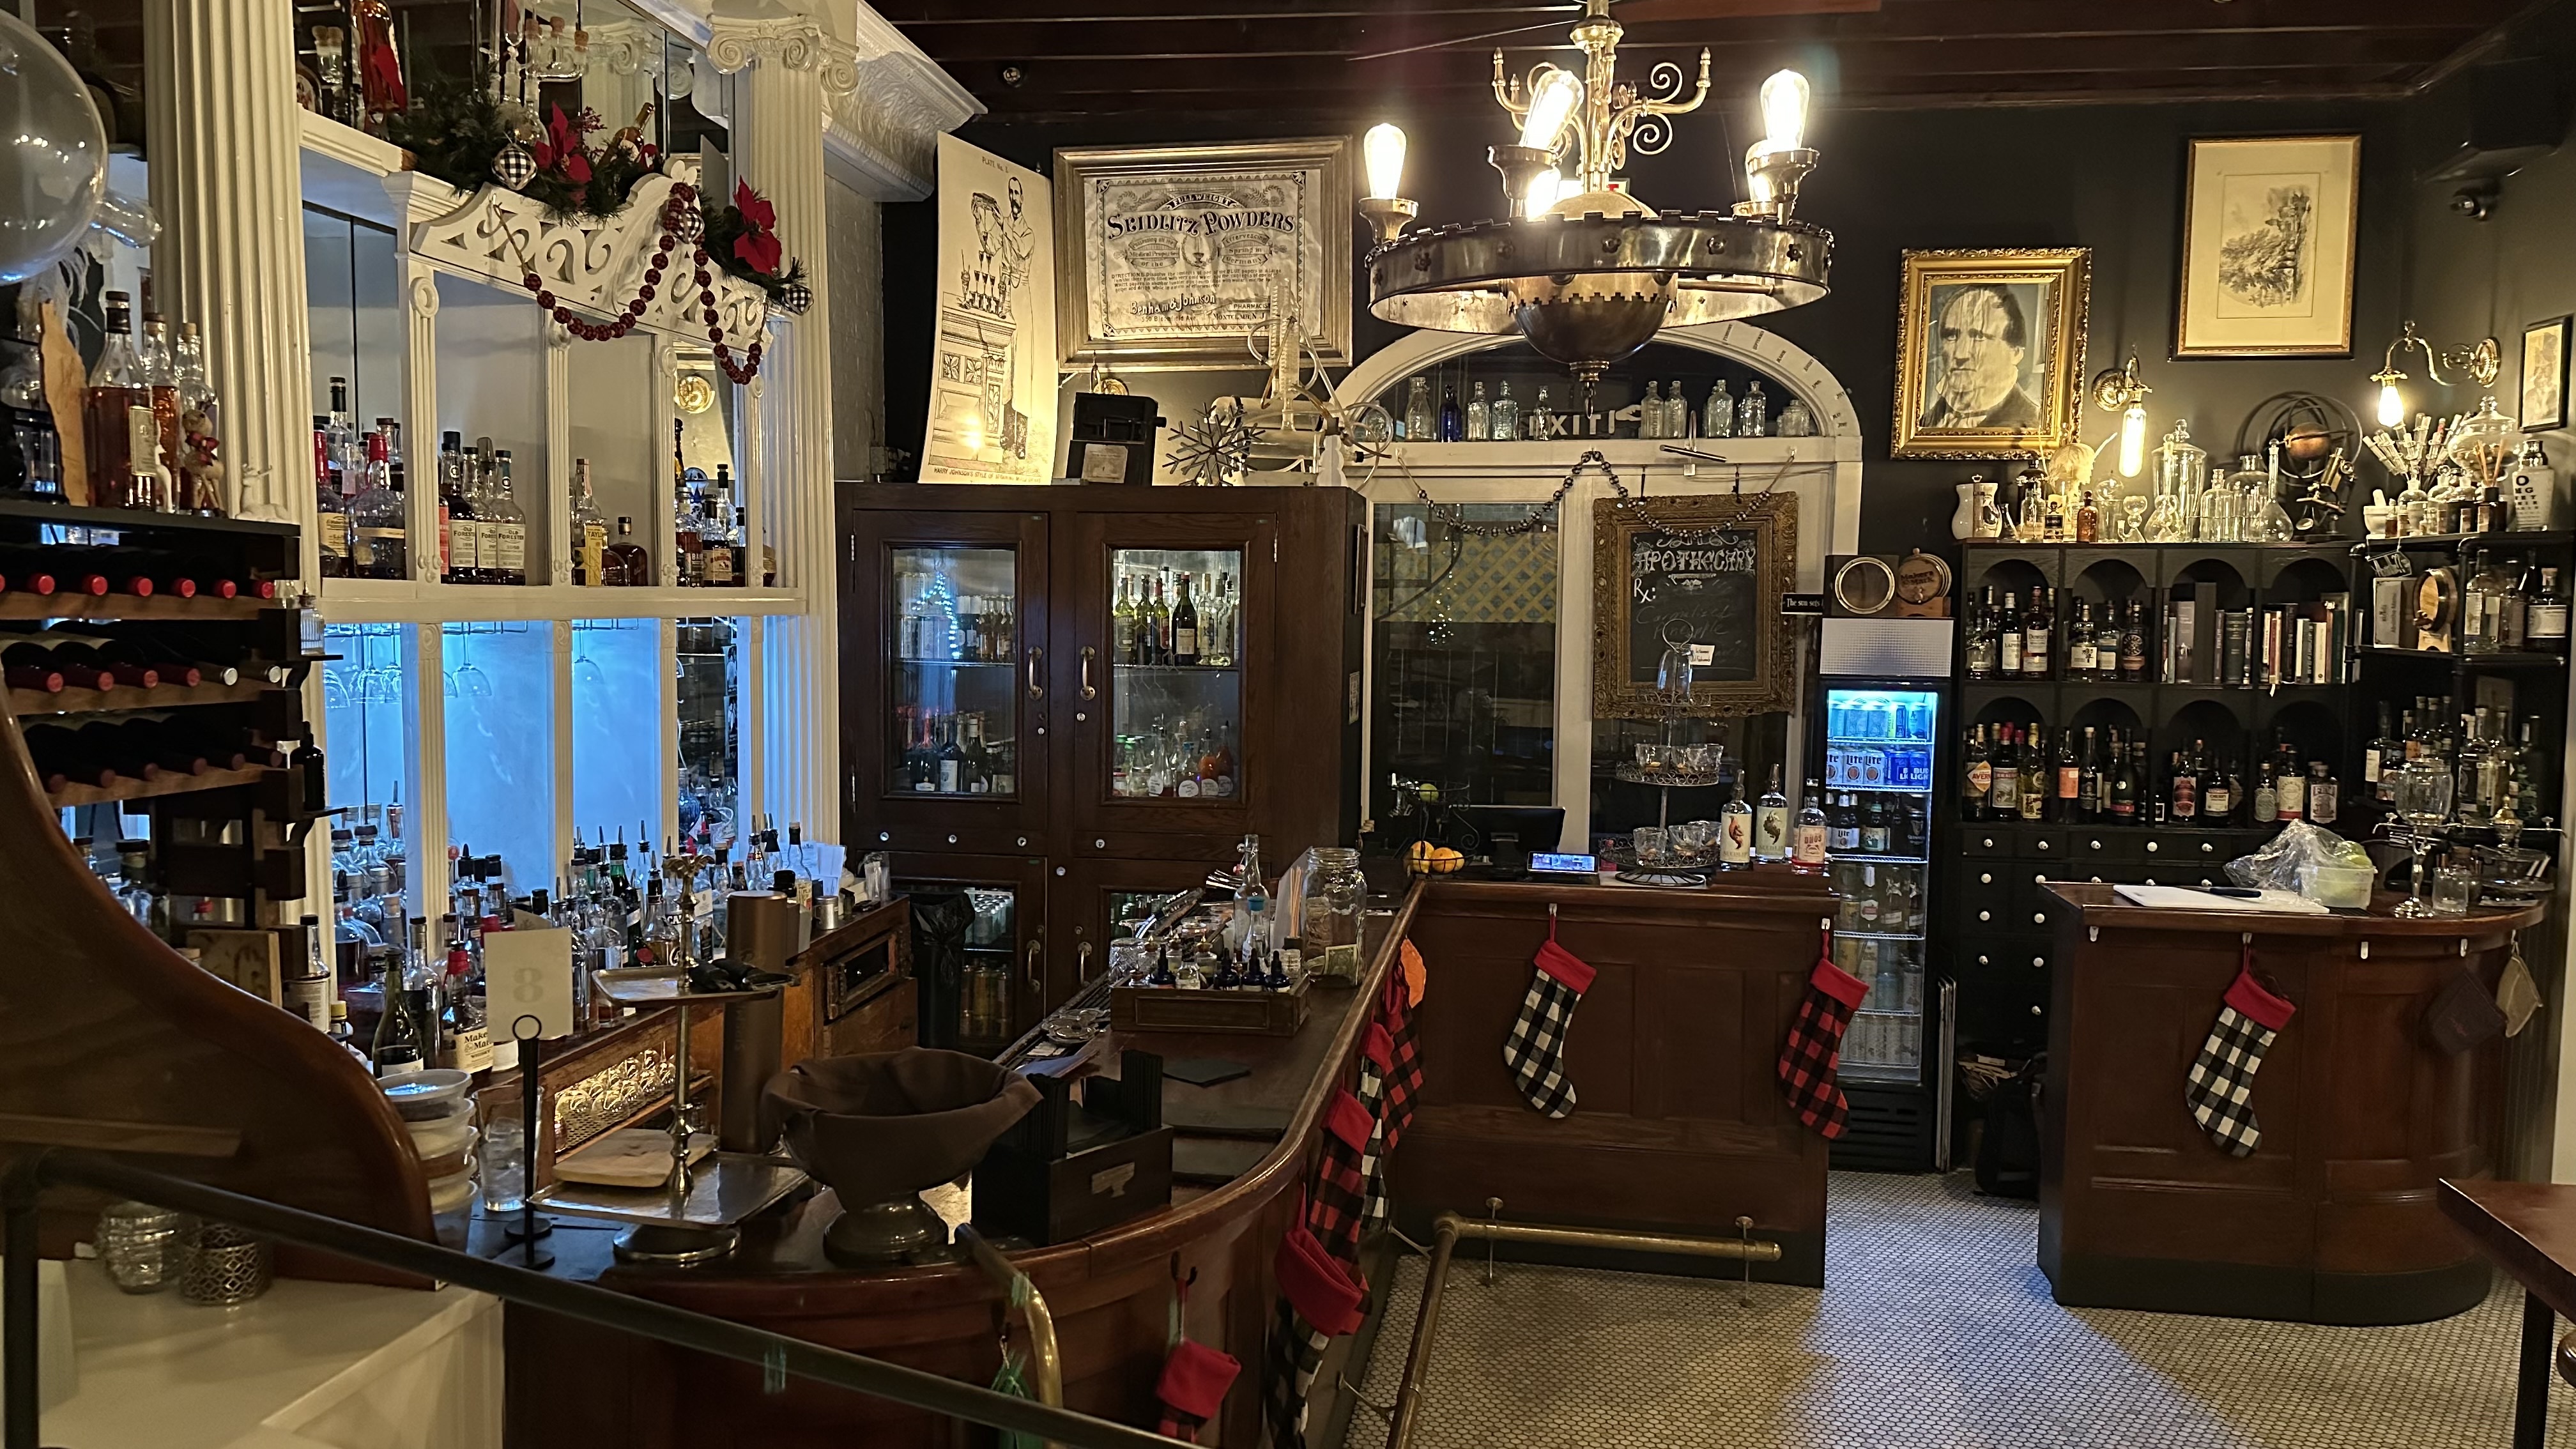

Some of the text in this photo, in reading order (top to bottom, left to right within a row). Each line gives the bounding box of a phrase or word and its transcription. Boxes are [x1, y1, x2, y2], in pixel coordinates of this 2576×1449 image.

[1173, 193, 1230, 206] FULL WEIGHT
[1107, 211, 1295, 240] SEIDLITZ POWDERS
[1130, 300, 1170, 315] Benham
[1177, 293, 1216, 312] Johnson
[1633, 548, 1756, 572] APOTHECARY
[1787, 598, 1797, 607] The
[1846, 755, 1863, 765] Lite
[1866, 755, 1882, 766] Lite
[513, 968, 544, 1003] 8
[474, 1040, 492, 1050] Mar
